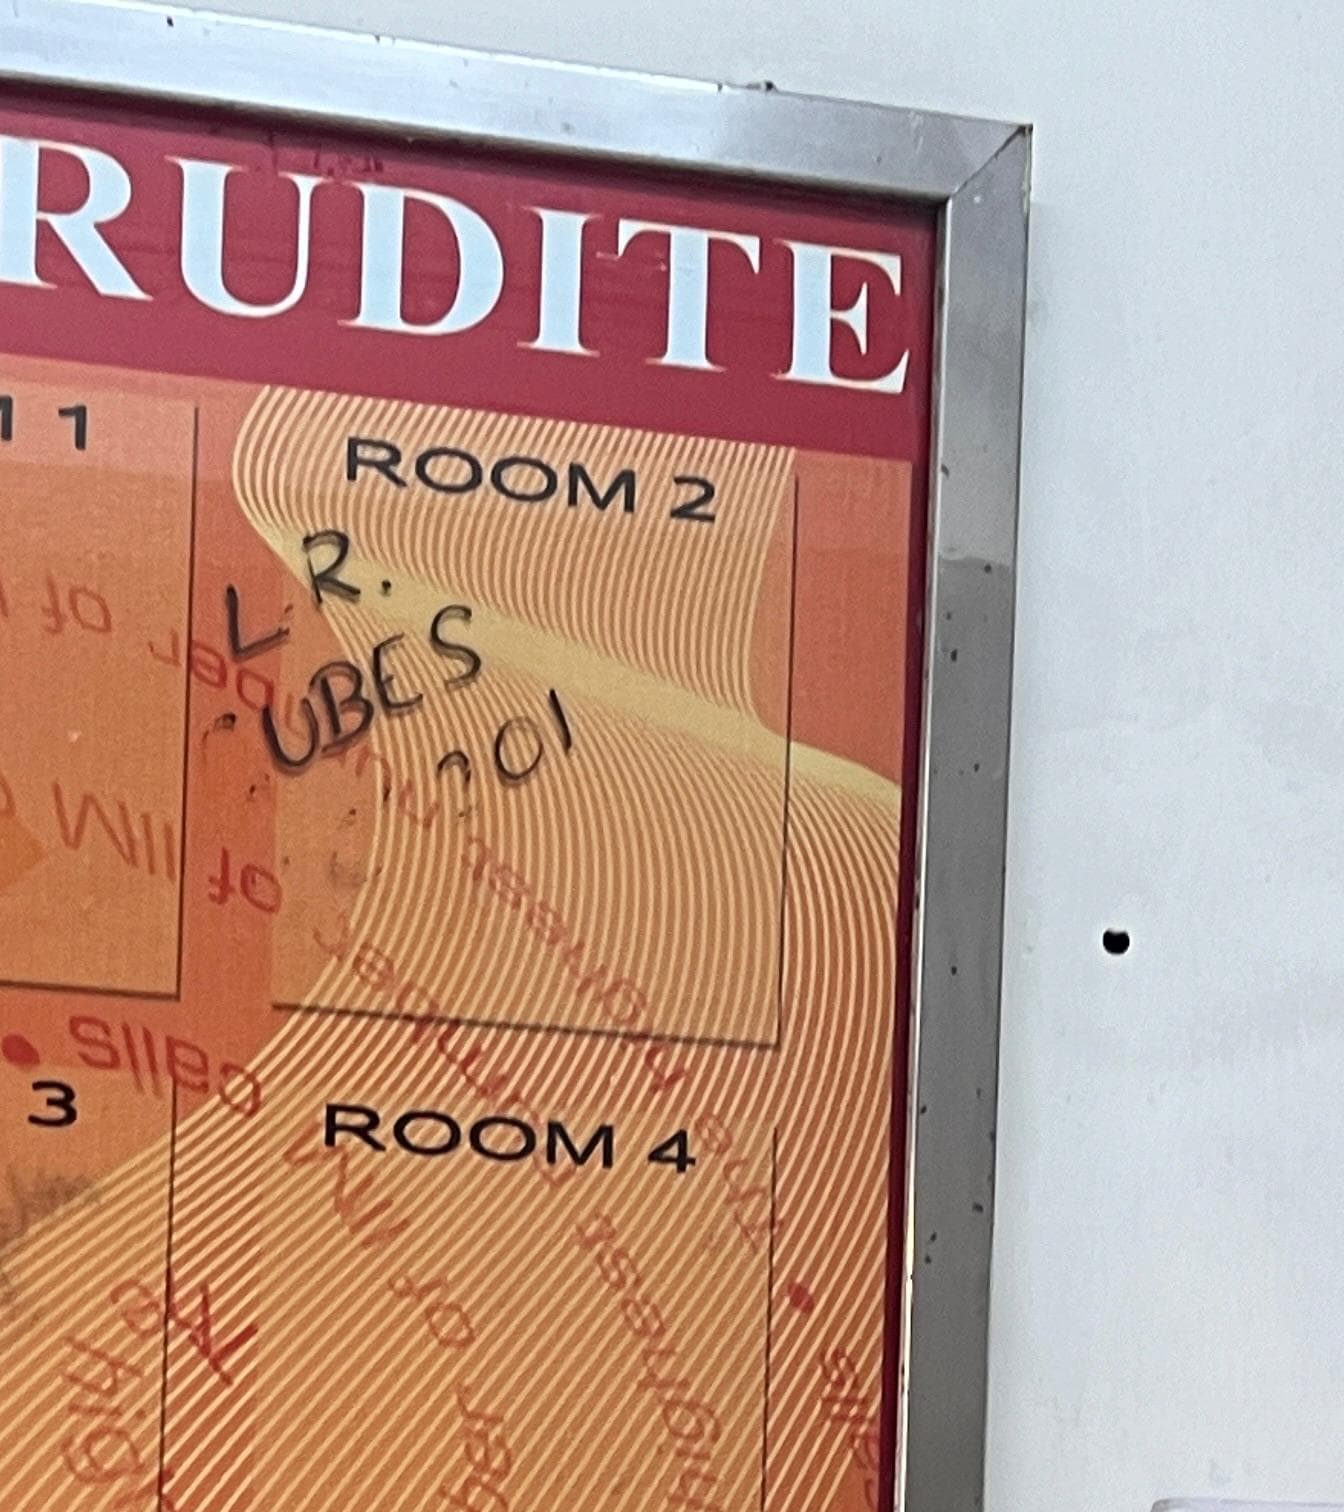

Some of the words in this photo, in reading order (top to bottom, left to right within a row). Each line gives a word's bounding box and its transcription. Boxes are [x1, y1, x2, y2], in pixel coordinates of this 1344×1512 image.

[58, 404, 89, 450] 1
[345, 436, 636, 514] ROOM
[668, 476, 716, 524] 2
[27, 1080, 79, 1127] 3
[323, 1102, 615, 1169] ROOM
[648, 1128, 698, 1174] 4
